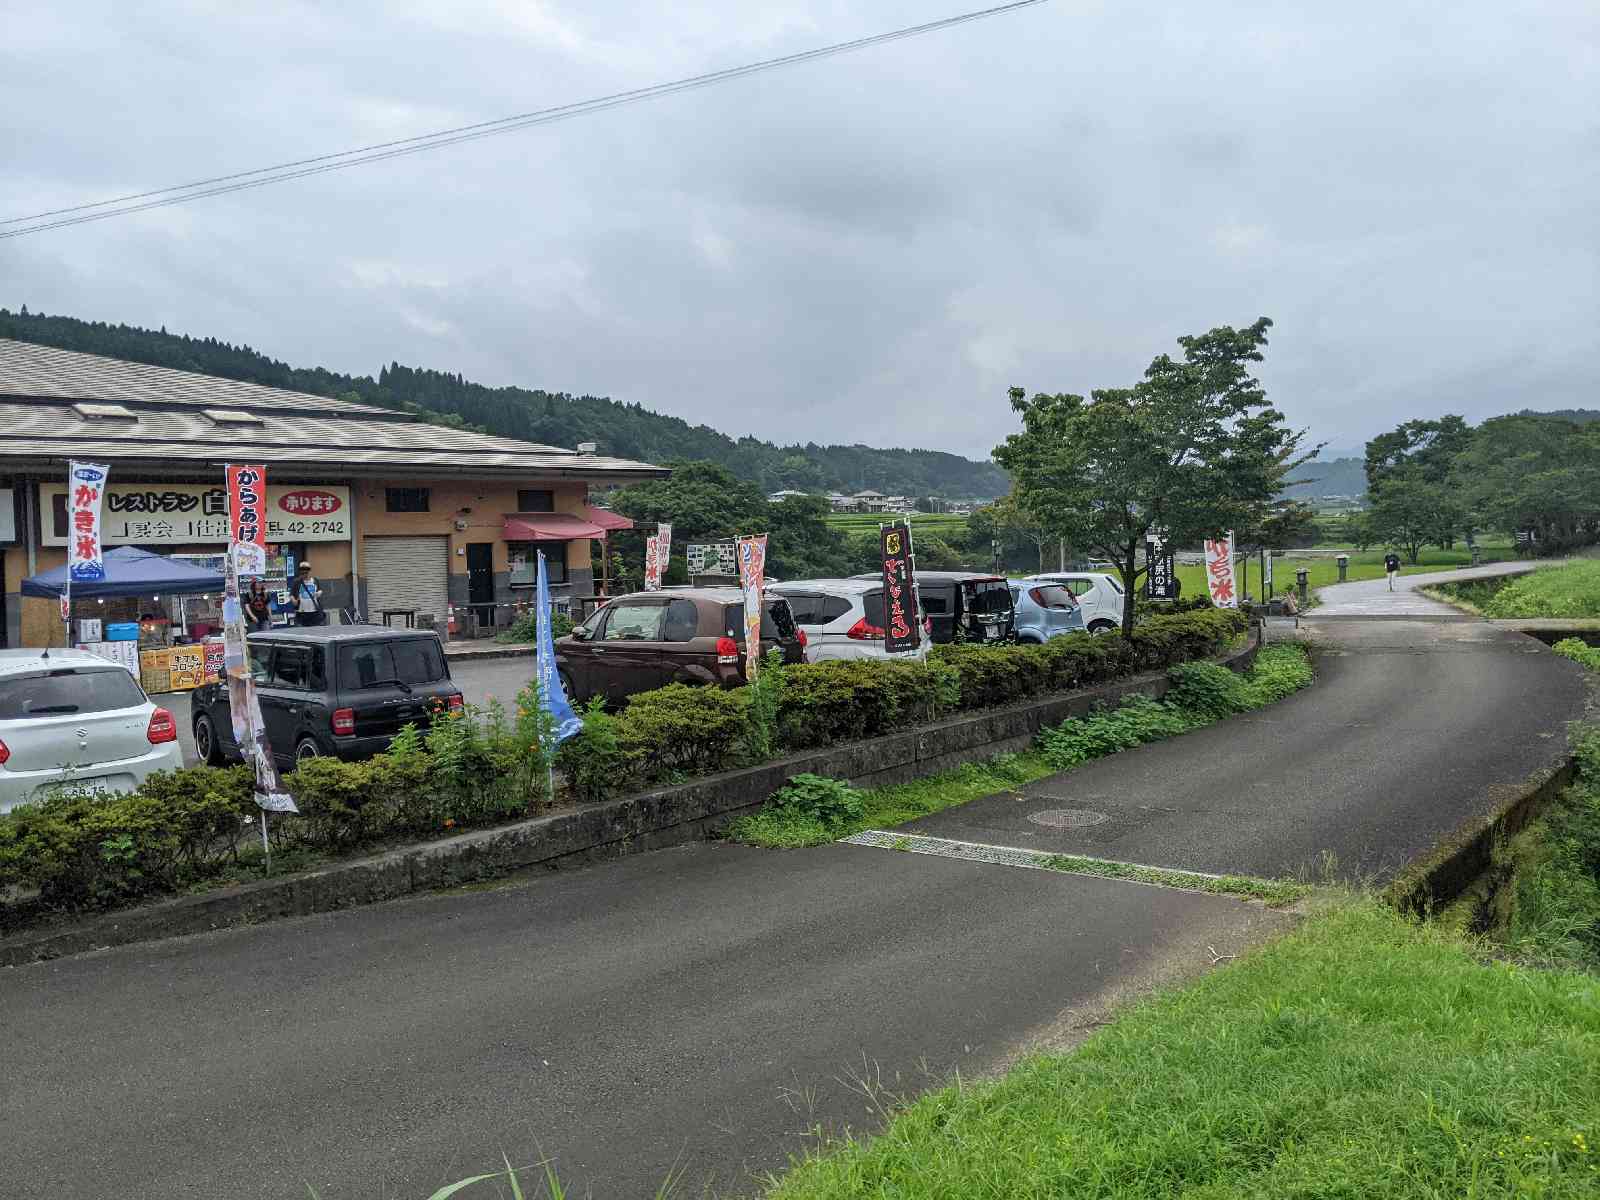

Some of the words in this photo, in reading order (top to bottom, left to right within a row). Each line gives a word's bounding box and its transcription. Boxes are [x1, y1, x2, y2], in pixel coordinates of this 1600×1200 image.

[107, 491, 198, 514] レストラン
[237, 469, 259, 543] からあげ
[286, 495, 336, 511] 承ります
[75, 484, 98, 559] かき氷
[264, 521, 285, 532] EL
[287, 521, 344, 534] 42-2742
